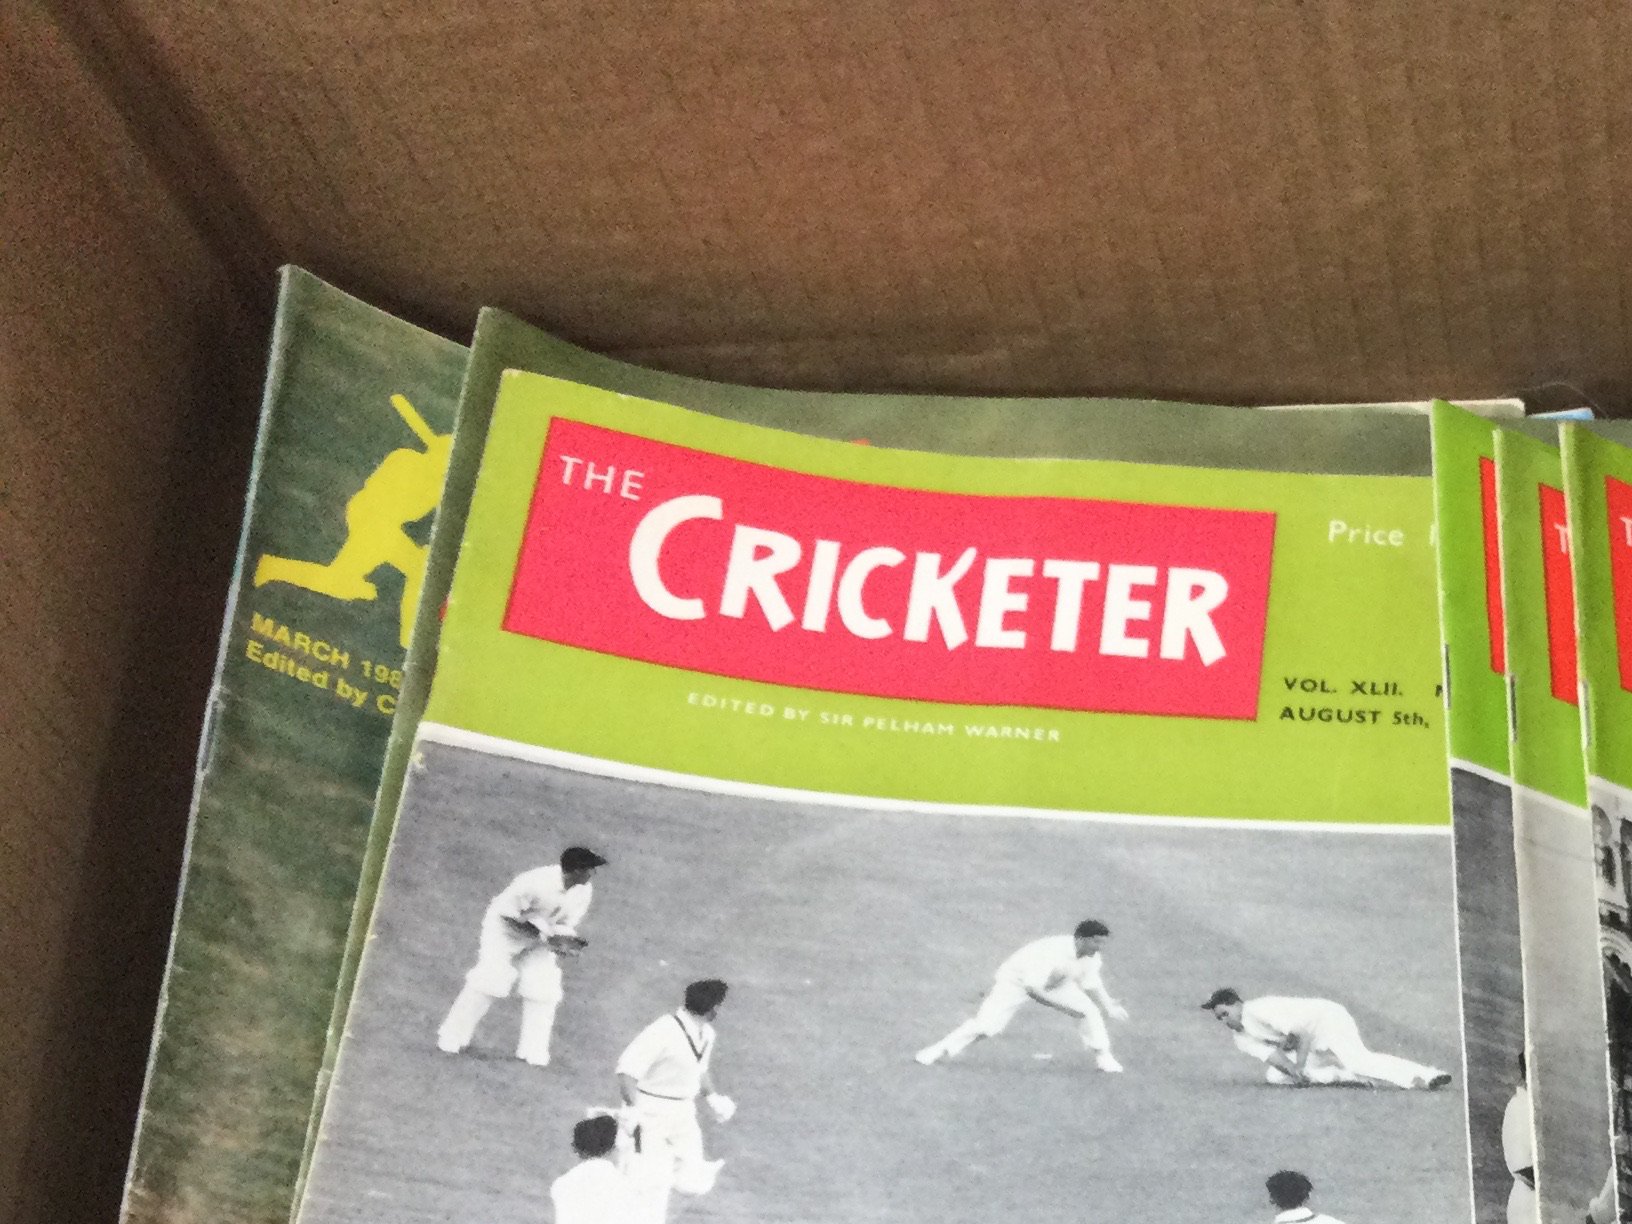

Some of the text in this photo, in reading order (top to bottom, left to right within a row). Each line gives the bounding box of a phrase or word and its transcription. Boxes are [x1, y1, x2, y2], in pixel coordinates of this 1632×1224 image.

[560, 455, 645, 501] THE
[1328, 519, 1404, 547] Price
[251, 612, 350, 669] MARCH
[246, 640, 329, 689] Edited
[336, 678, 368, 708] by
[1284, 677, 1403, 696] VOL. XLII.
[687, 692, 1061, 742] EDITED BY SIR PELHAM WARNER
[1280, 706, 1429, 728] AUGUST 5th,
